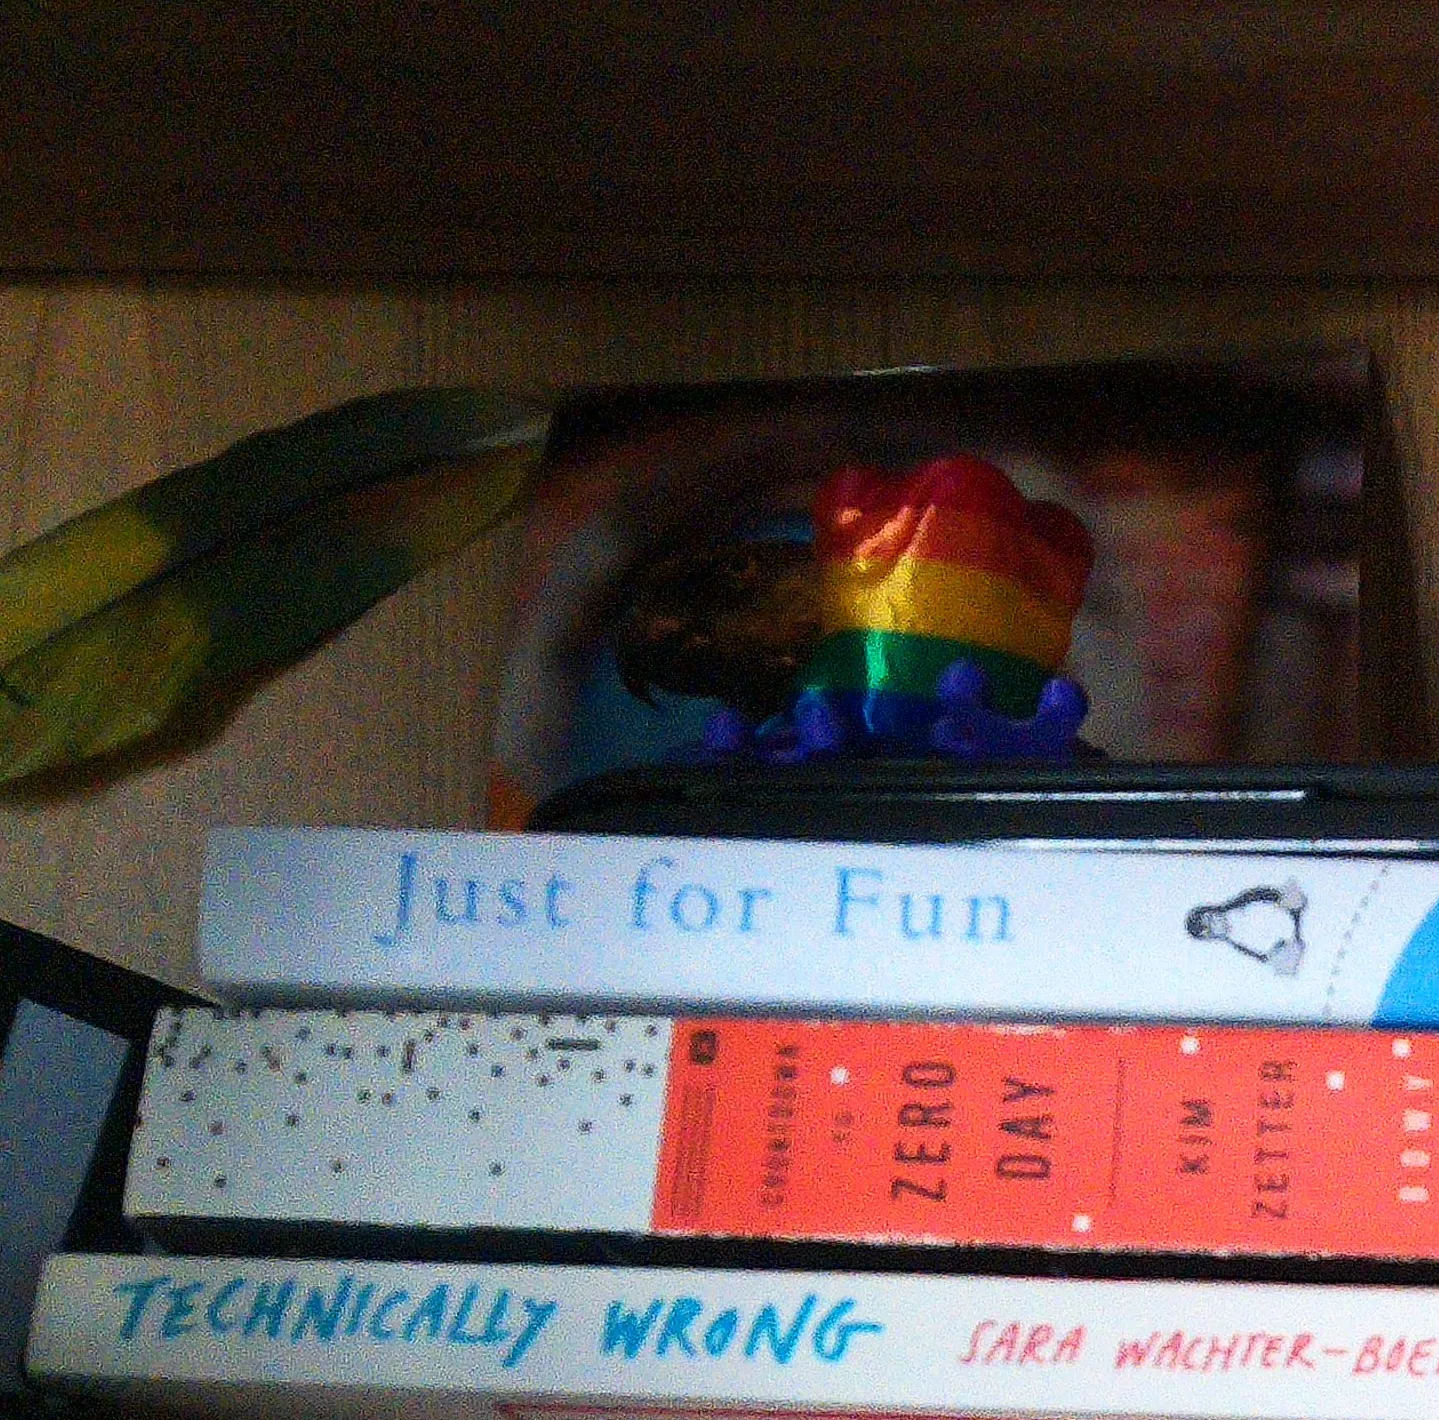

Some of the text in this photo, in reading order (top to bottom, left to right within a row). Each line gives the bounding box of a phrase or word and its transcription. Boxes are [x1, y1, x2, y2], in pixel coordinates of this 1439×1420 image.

[373, 853, 1012, 947] Just for Fun
[890, 1059, 957, 1203] ZERO
[993, 1075, 1056, 1182] DAY
[1176, 1099, 1213, 1175] KIM
[1251, 1059, 1296, 1220] ZETTER
[115, 1272, 556, 1368] TECHNICALLY
[602, 1292, 884, 1364] WRONG
[959, 1318, 1086, 1365] SARA
